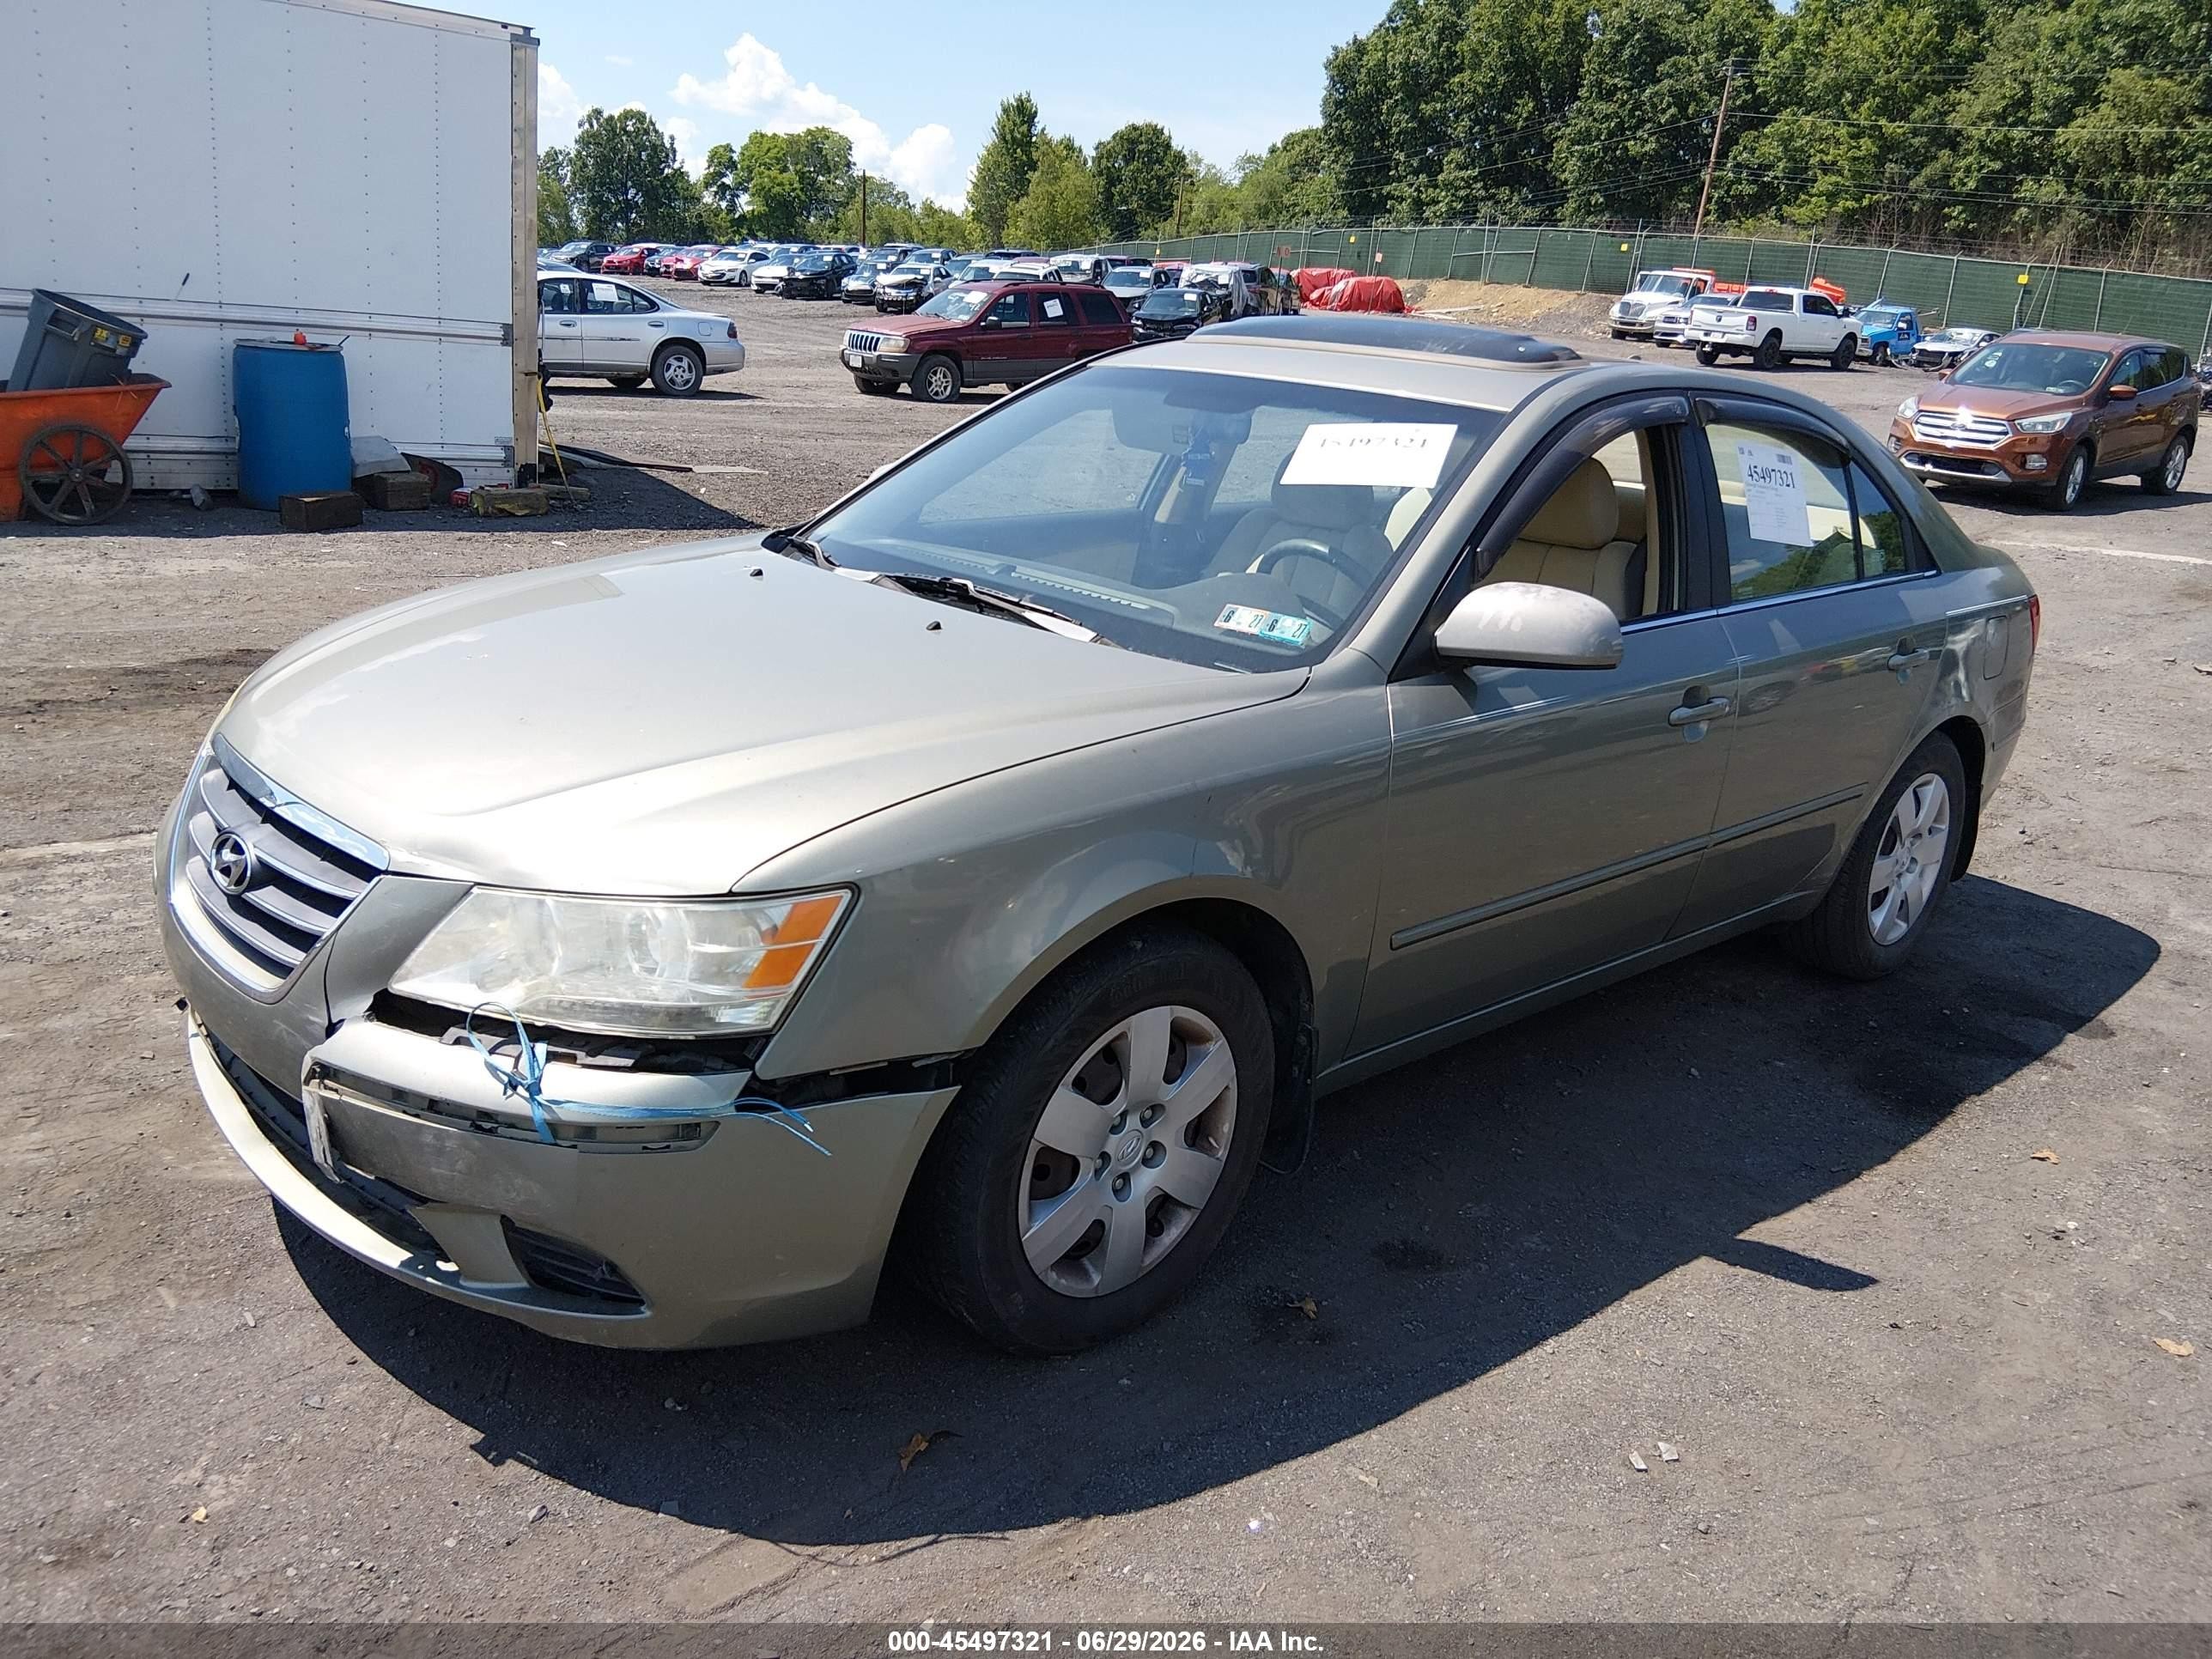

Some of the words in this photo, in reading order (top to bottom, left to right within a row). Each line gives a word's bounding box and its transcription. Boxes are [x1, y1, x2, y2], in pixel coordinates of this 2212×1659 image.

[1747, 464, 1796, 489] 45497321
[1248, 614, 1264, 629] 27
[1291, 623, 1307, 639] 27
